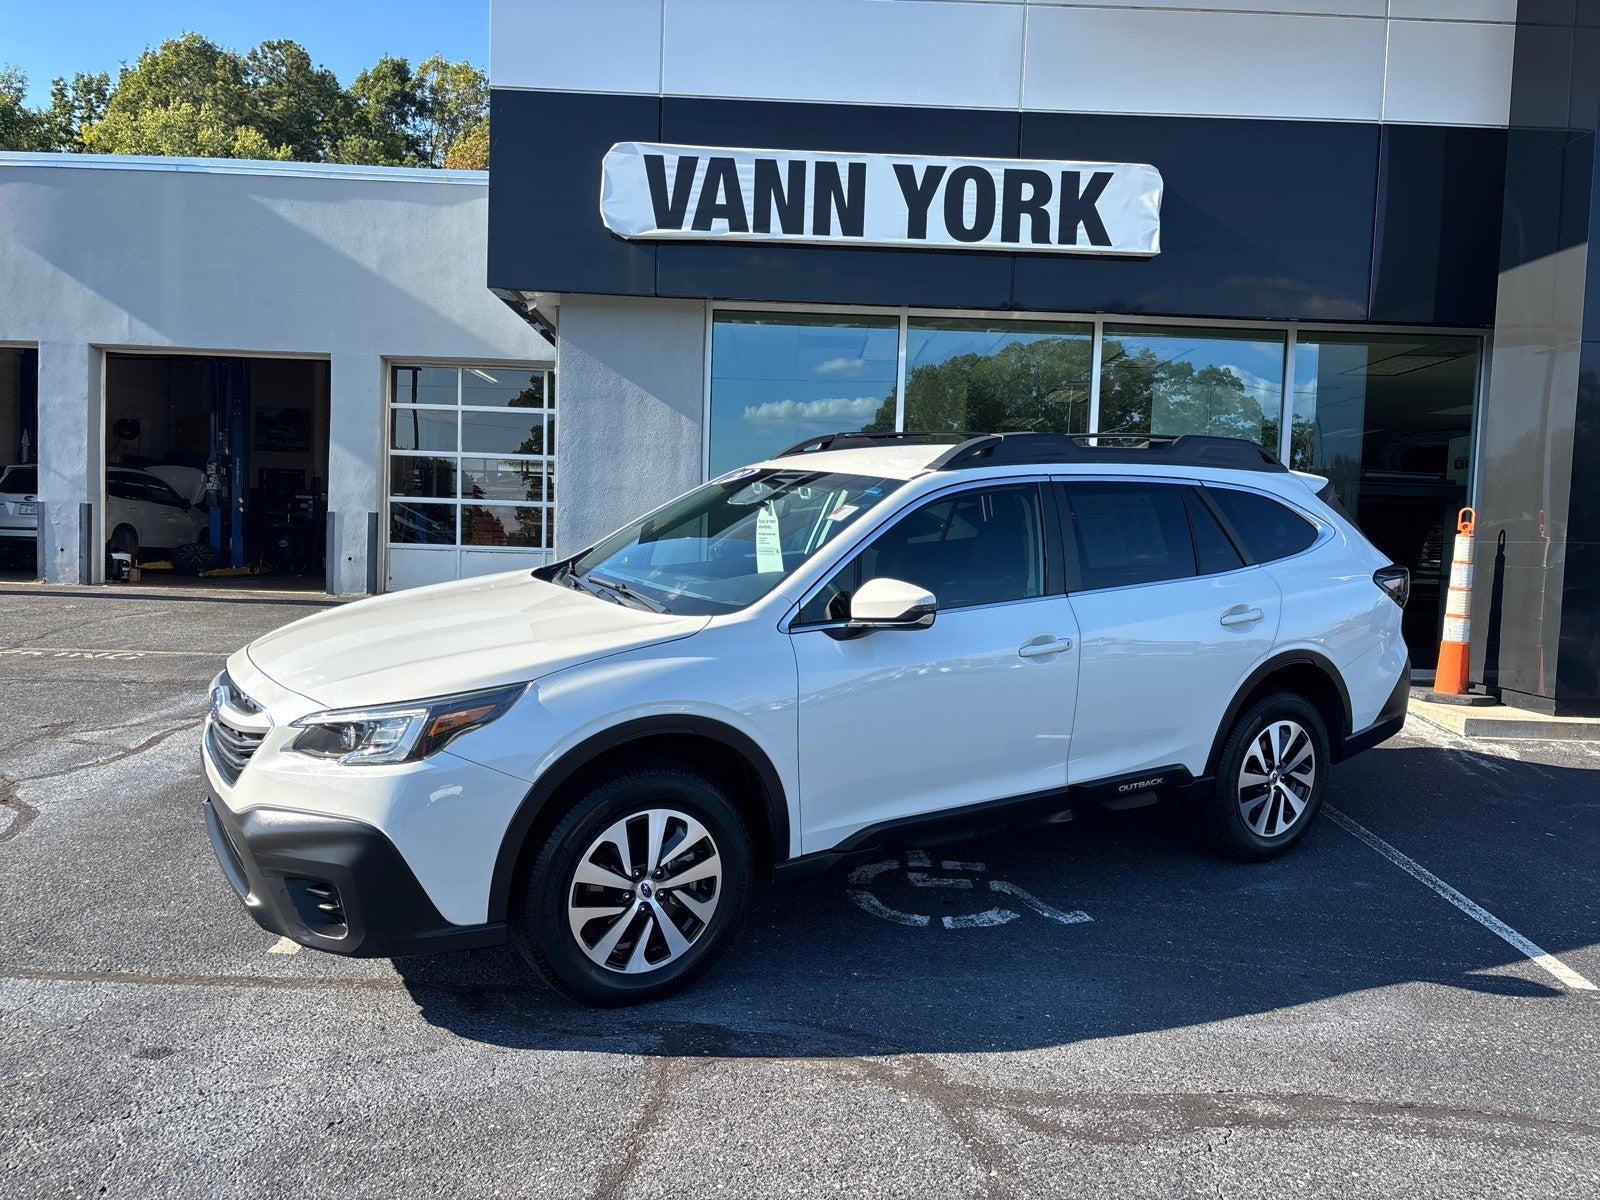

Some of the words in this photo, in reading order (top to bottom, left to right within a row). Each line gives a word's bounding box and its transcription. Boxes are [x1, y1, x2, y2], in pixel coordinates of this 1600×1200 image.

[643, 154, 867, 238] VANN
[892, 163, 1115, 247] YORK
[1118, 777, 1163, 792] OUTBACK
